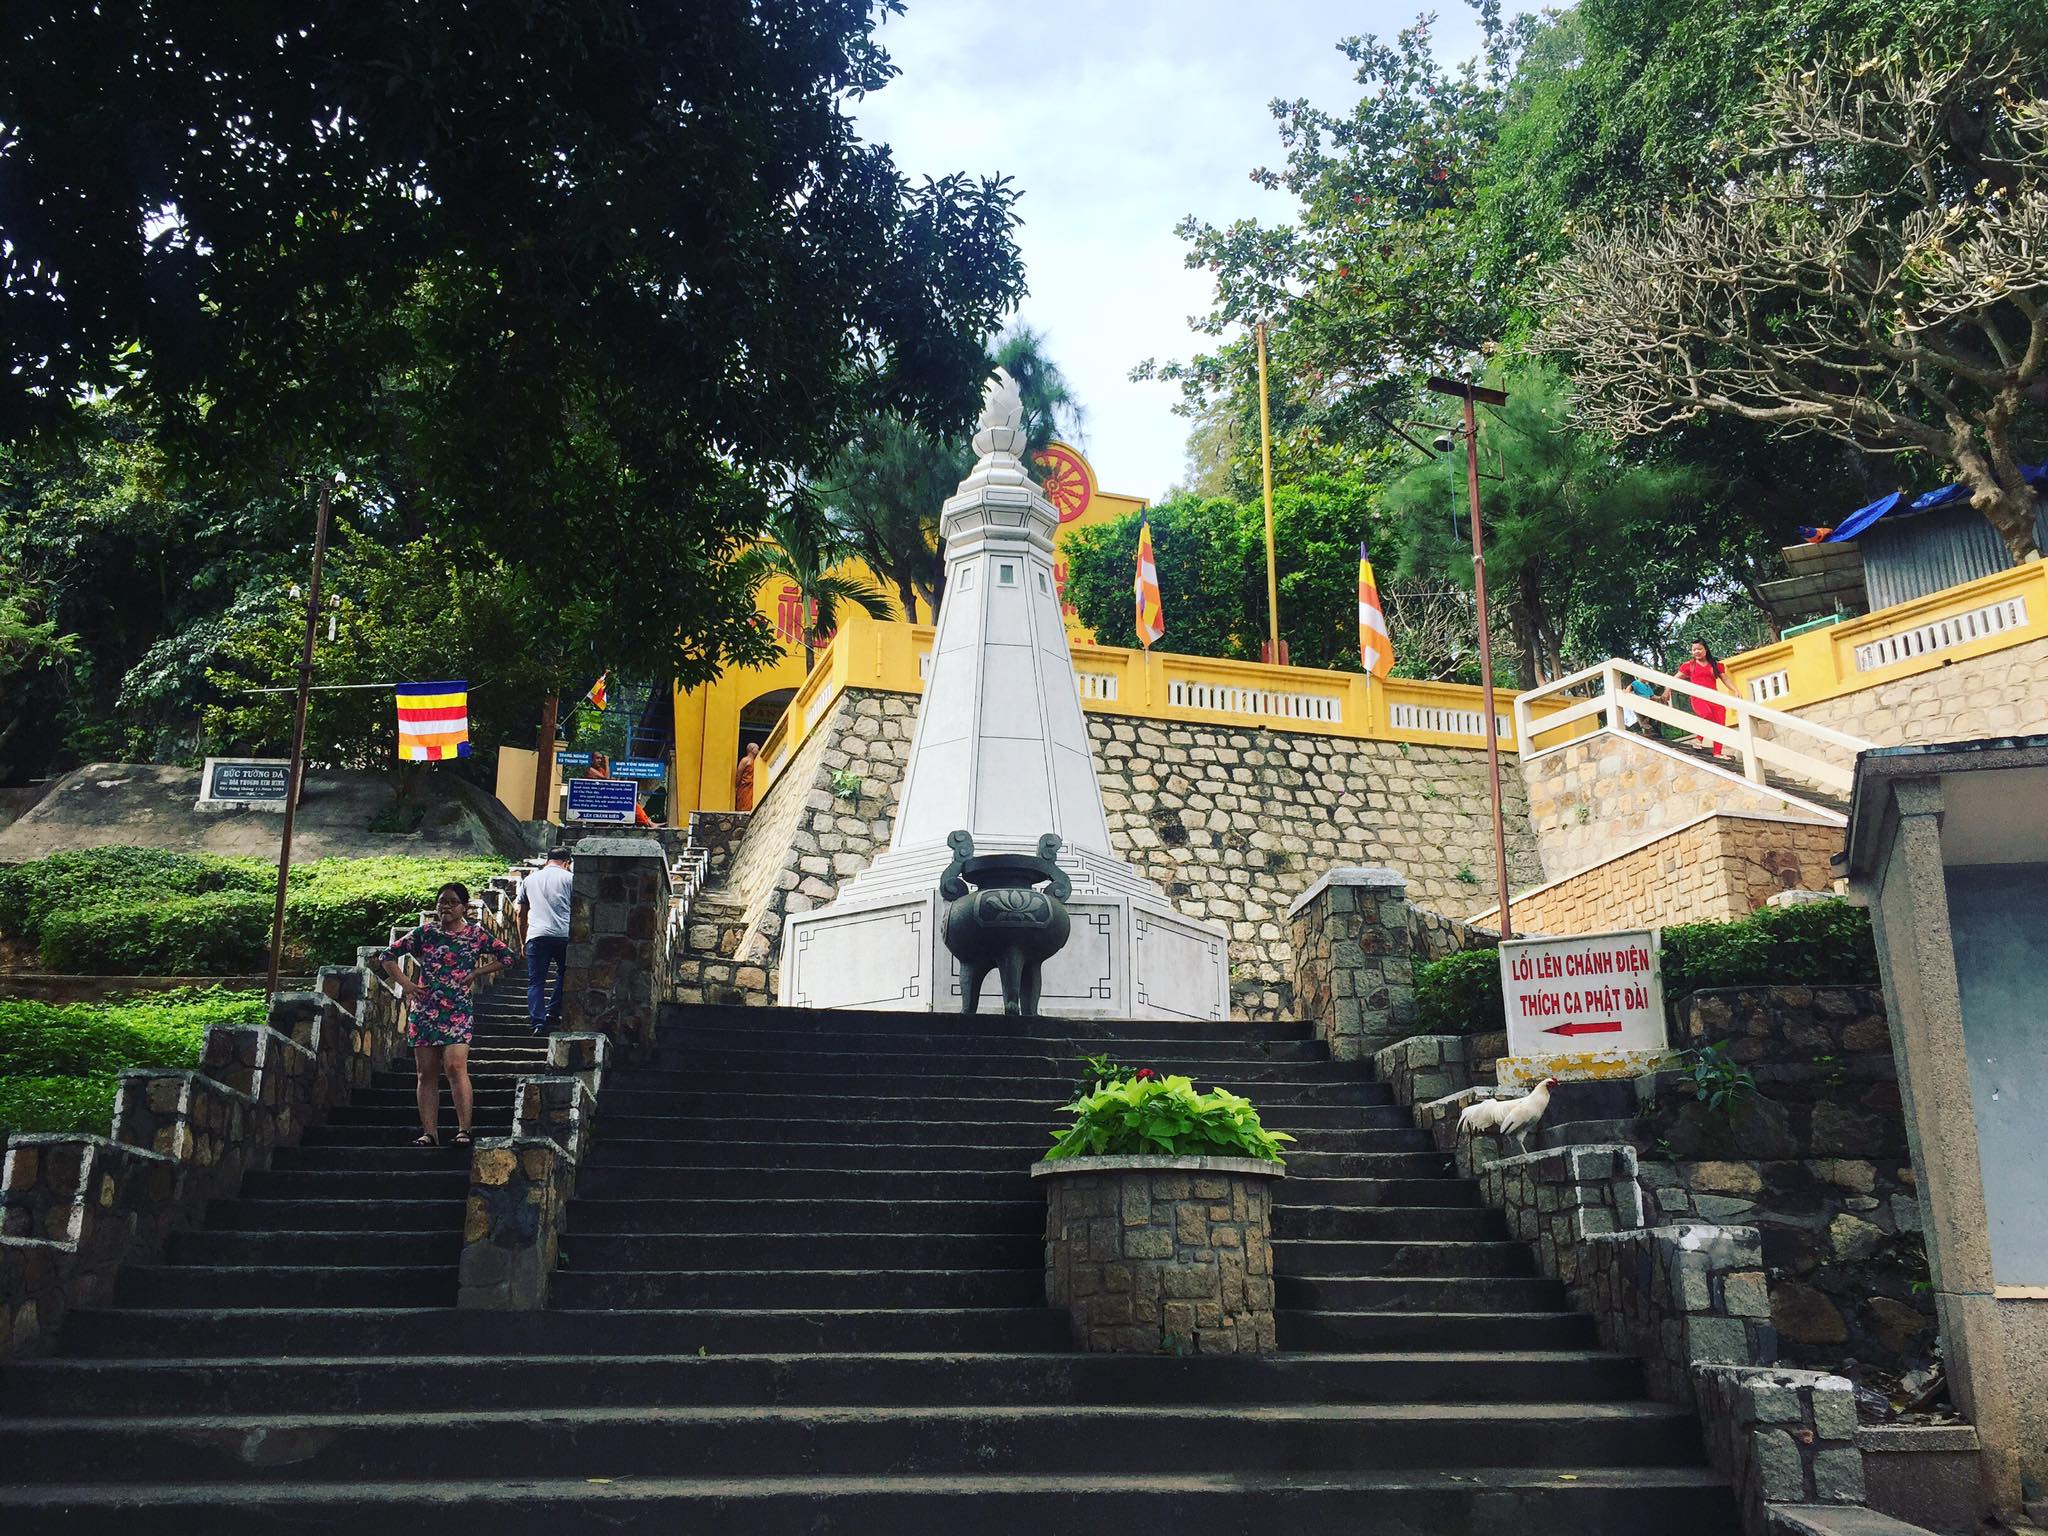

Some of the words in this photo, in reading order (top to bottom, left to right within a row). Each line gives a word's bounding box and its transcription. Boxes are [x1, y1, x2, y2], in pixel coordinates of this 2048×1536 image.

[1512, 949, 1533, 981] LỐI
[1536, 952, 1562, 980] LÊN
[1565, 947, 1613, 977] CHÁNH
[1615, 944, 1650, 978] ĐIỆN
[1519, 988, 1561, 1017] THÍCH
[1564, 991, 1582, 1015] CA
[1584, 984, 1620, 1017] PHẬT
[1624, 981, 1649, 1010] ĐÀI
